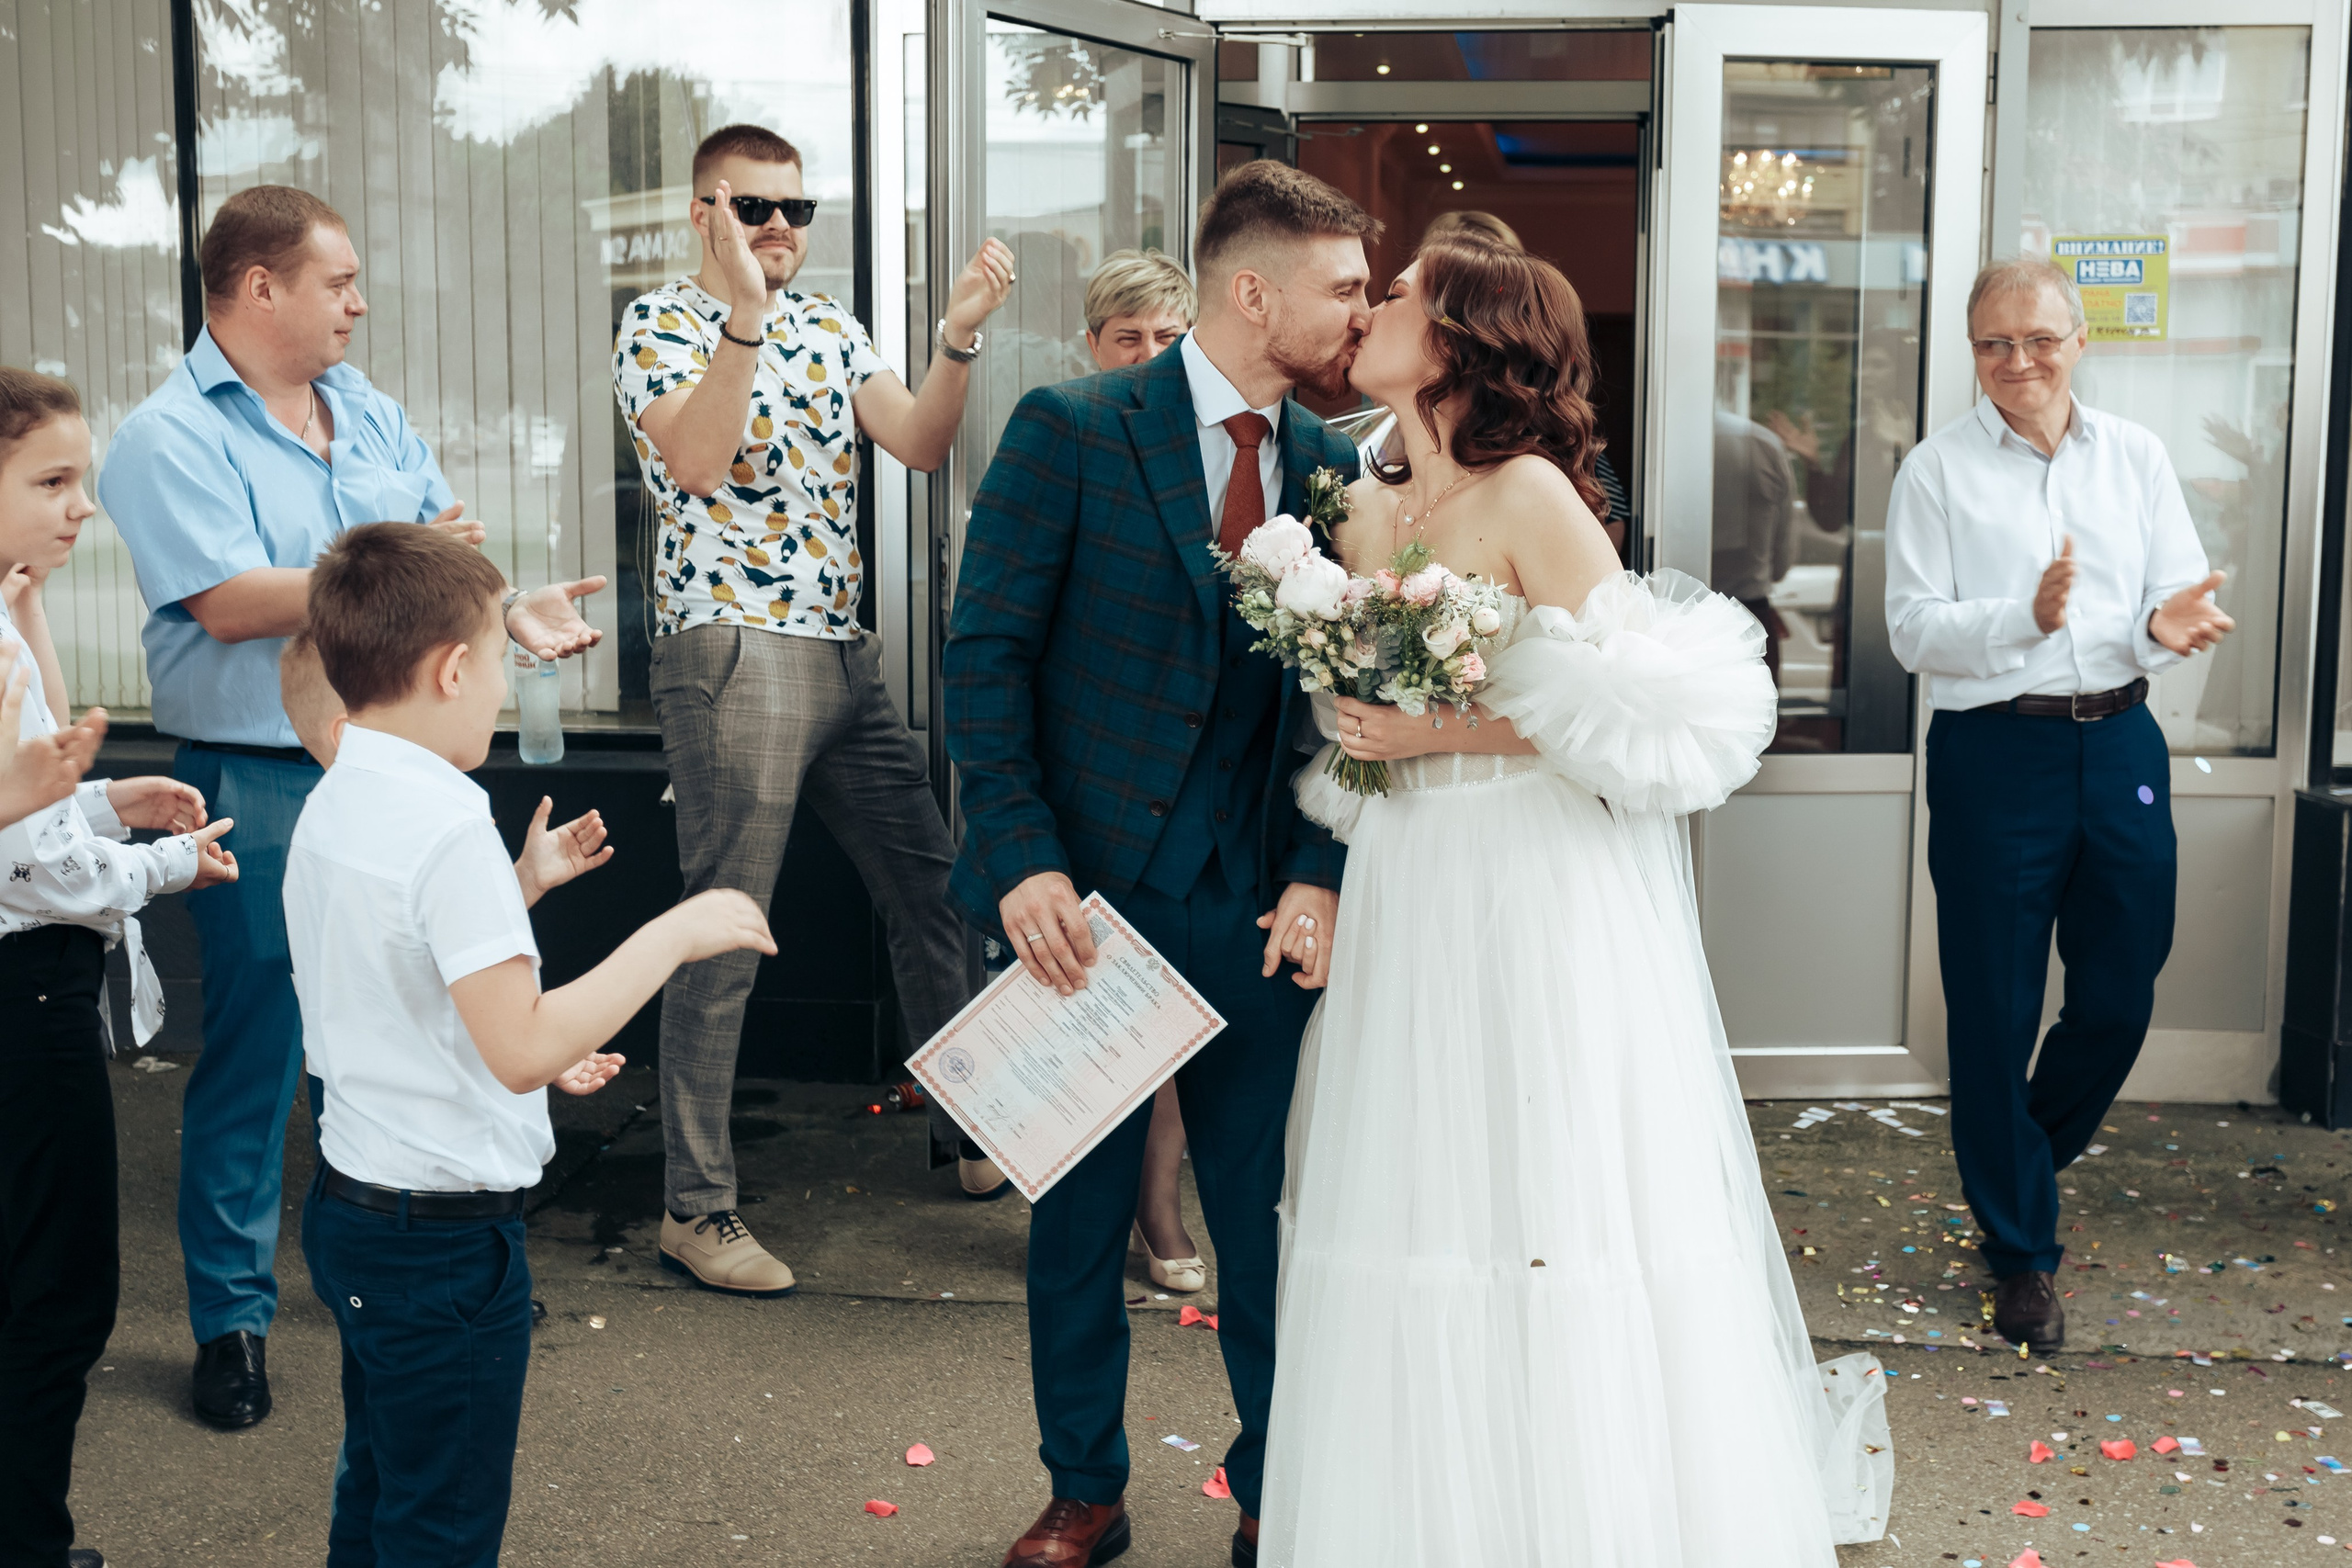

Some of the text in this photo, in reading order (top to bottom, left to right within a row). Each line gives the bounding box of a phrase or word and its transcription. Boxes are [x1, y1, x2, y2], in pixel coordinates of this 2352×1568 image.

[2080, 261, 2141, 277] НЕВА
[1119, 956, 1159, 997] СВИДЕТЕЛЬСТВО
[1145, 992, 1161, 1010] БРАКА
